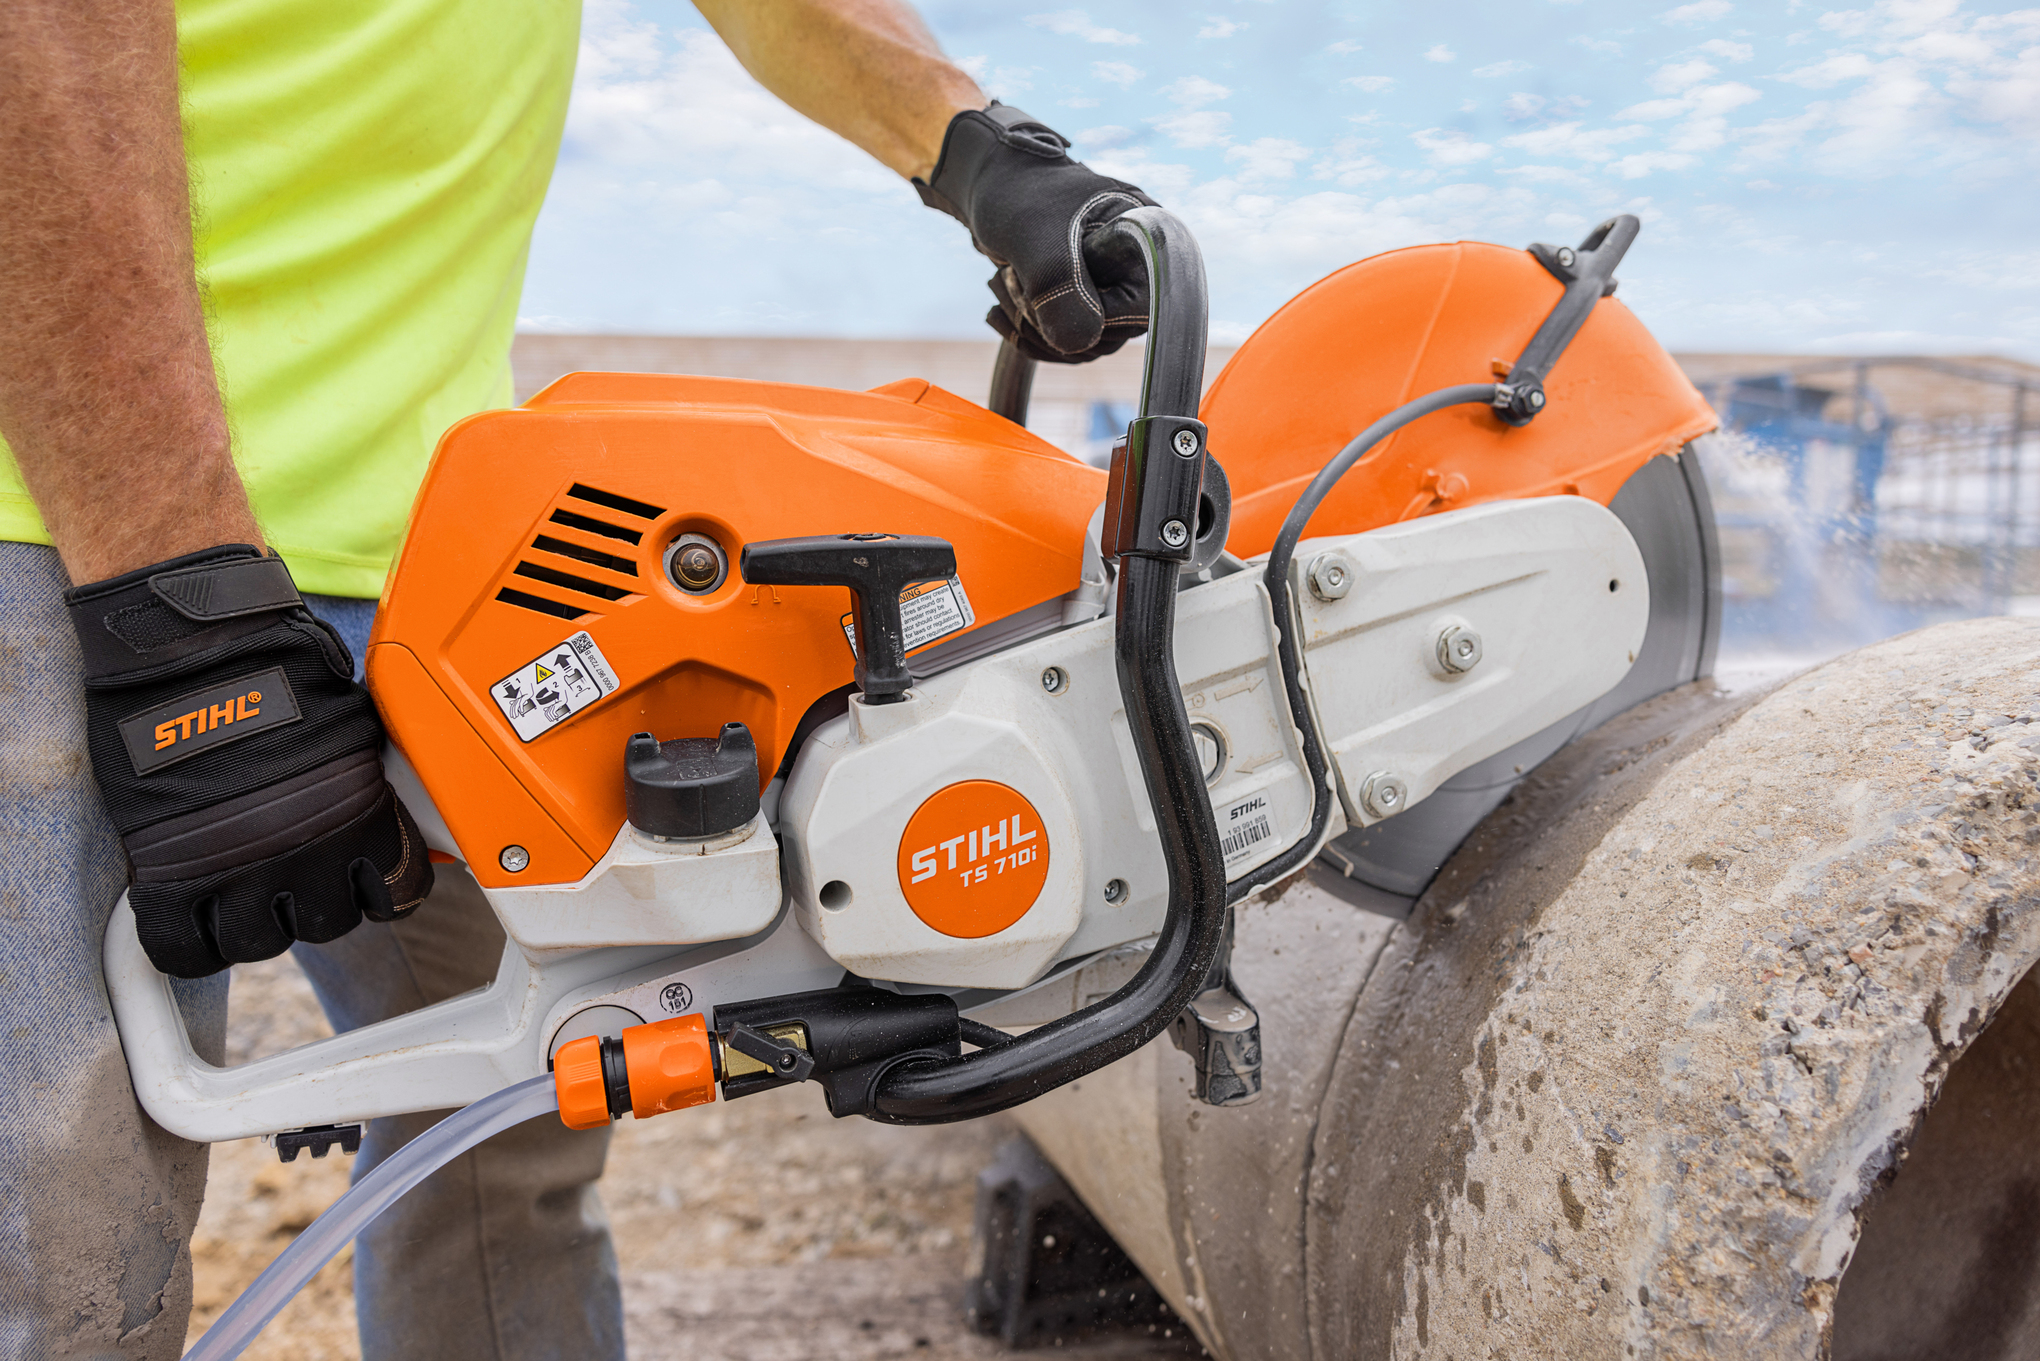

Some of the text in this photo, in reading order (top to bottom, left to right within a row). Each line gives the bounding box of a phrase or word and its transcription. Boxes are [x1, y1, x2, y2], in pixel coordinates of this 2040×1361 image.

[920, 594, 932, 602] may
[932, 587, 949, 597] create
[904, 608, 916, 616] fires
[917, 600, 935, 612] around
[904, 613, 924, 624] arrester
[925, 607, 936, 615] may
[914, 627, 926, 636] laws
[933, 613, 960, 628] regulations
[915, 616, 932, 628] should
[934, 608, 952, 620] contact
[588, 655, 599, 668] 7238
[603, 677, 614, 691] 0000
[1230, 797, 1266, 820] STIHL
[912, 814, 1037, 884] STIHL
[960, 845, 1037, 888] TS 710i
